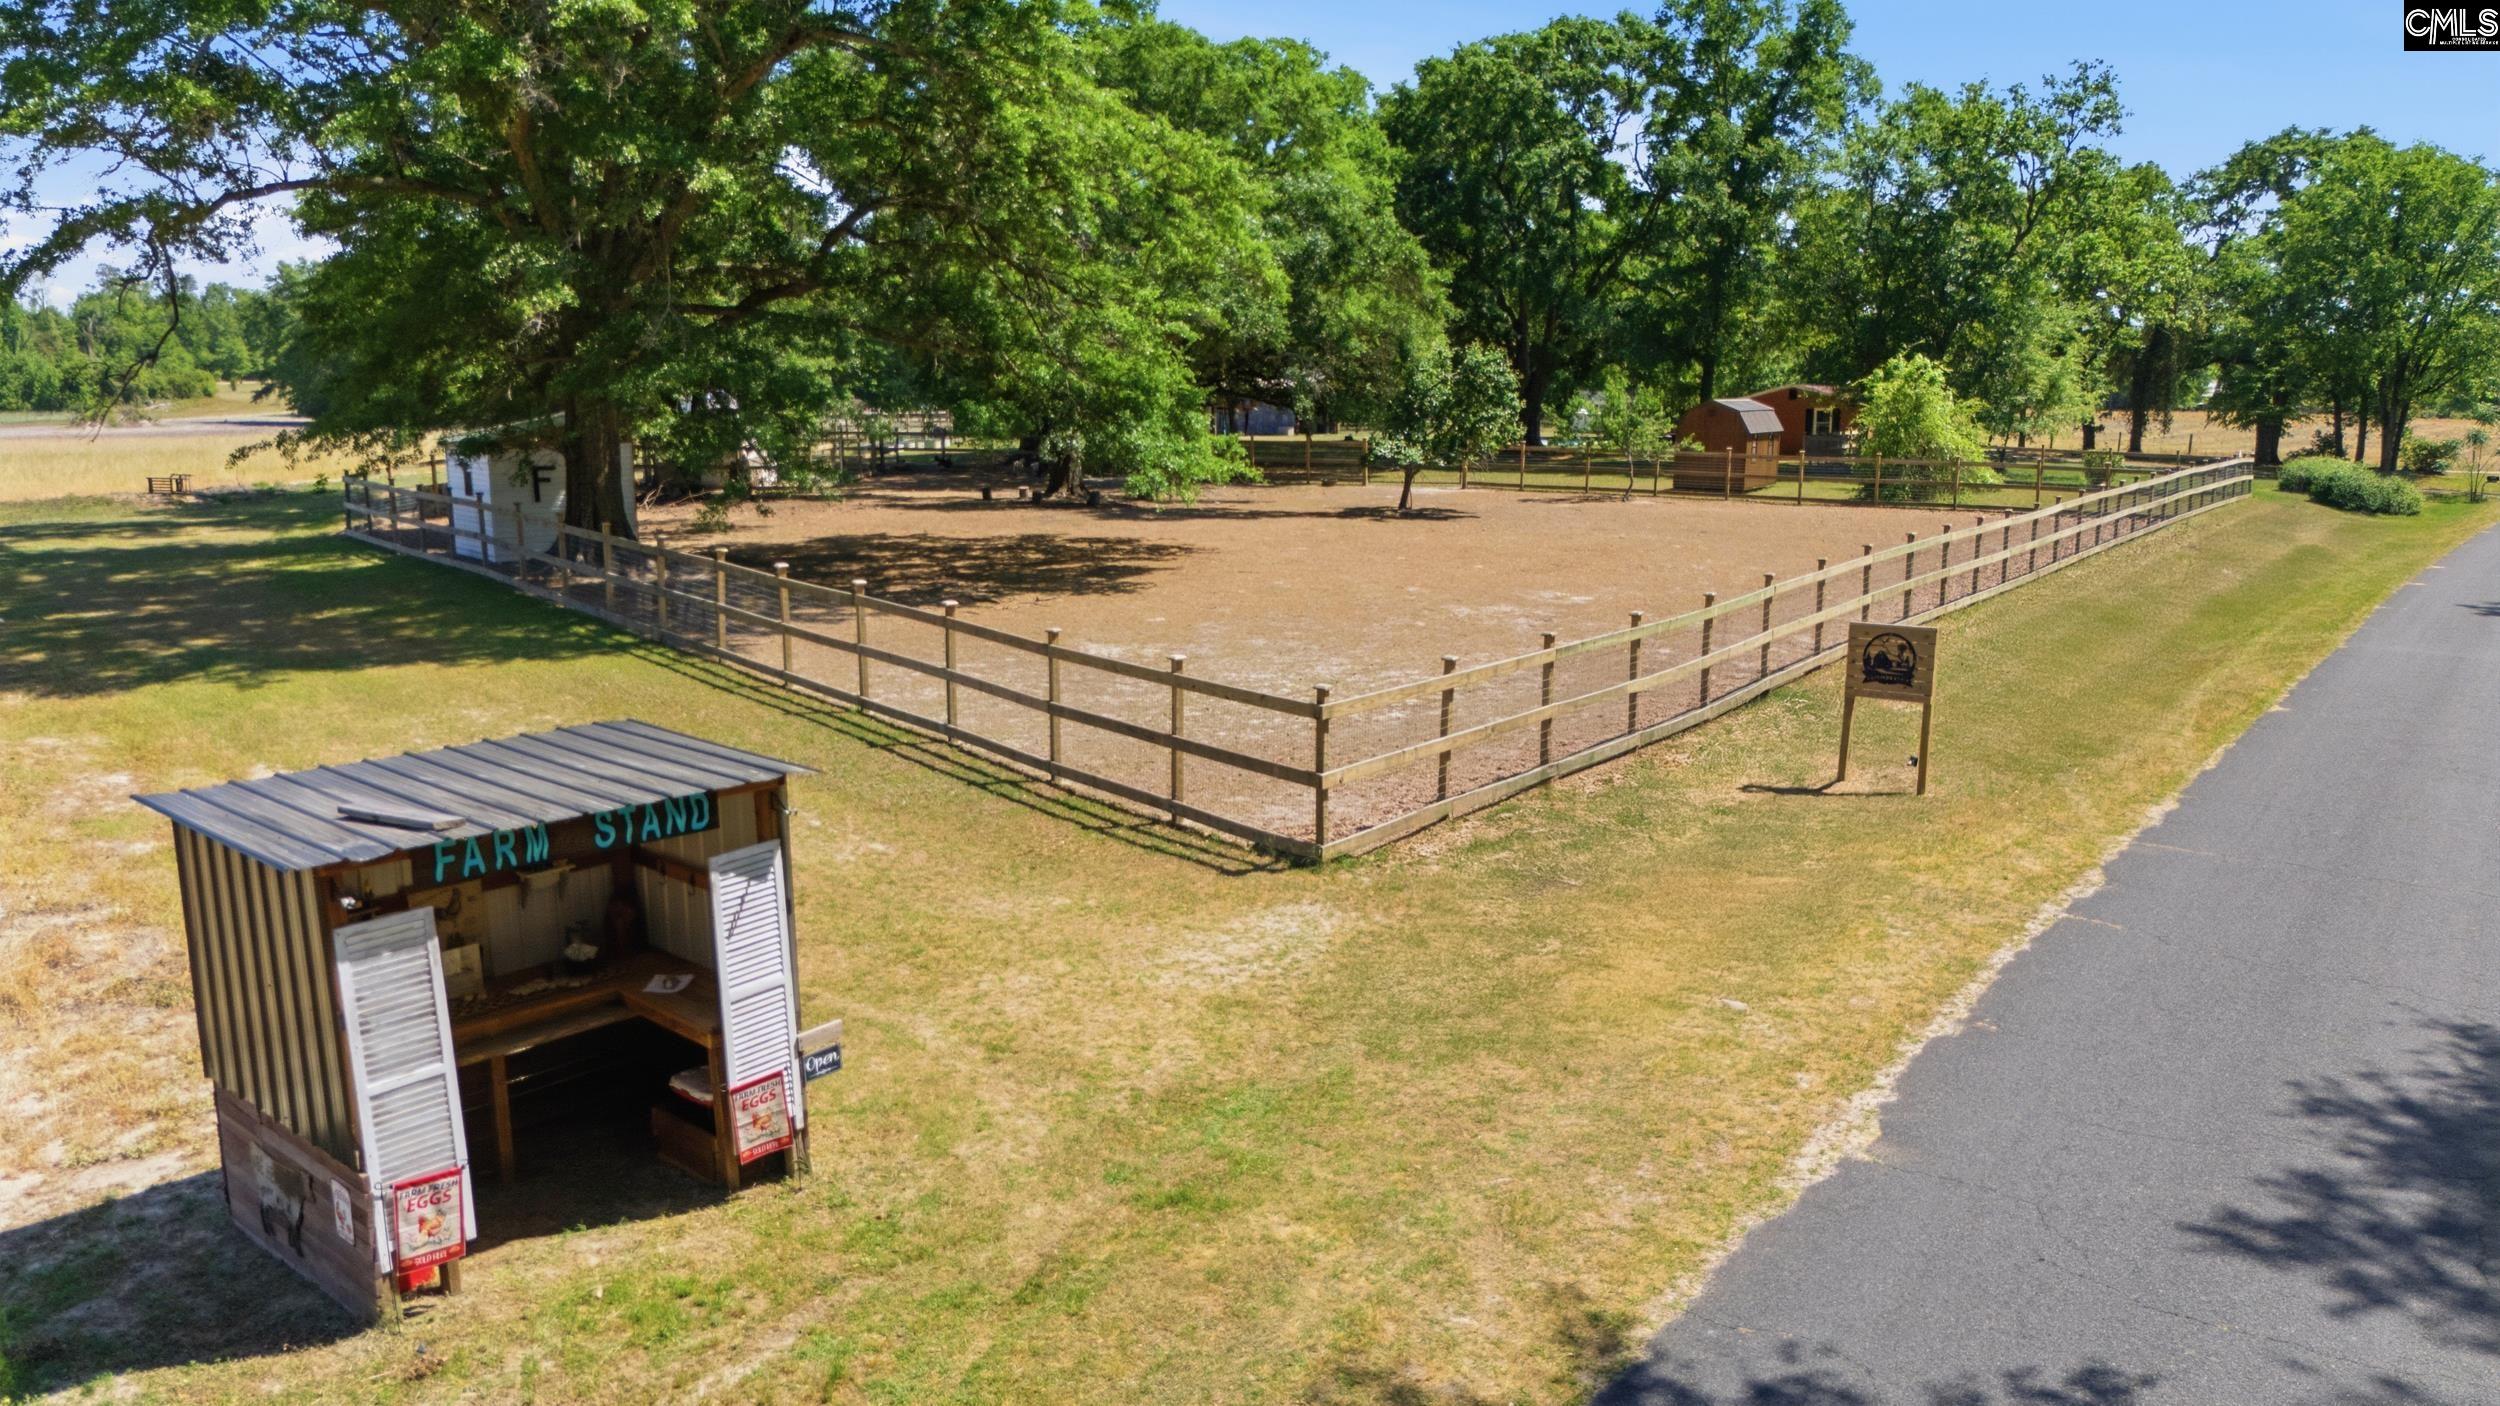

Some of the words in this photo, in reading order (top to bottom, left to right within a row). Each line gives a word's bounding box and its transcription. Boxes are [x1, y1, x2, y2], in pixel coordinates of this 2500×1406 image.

[434, 822, 549, 883] FARM
[593, 792, 710, 849] STAND
[805, 1051, 840, 1073] Open
[741, 1088, 776, 1112] EGGS
[407, 1188, 452, 1213] EGGS
